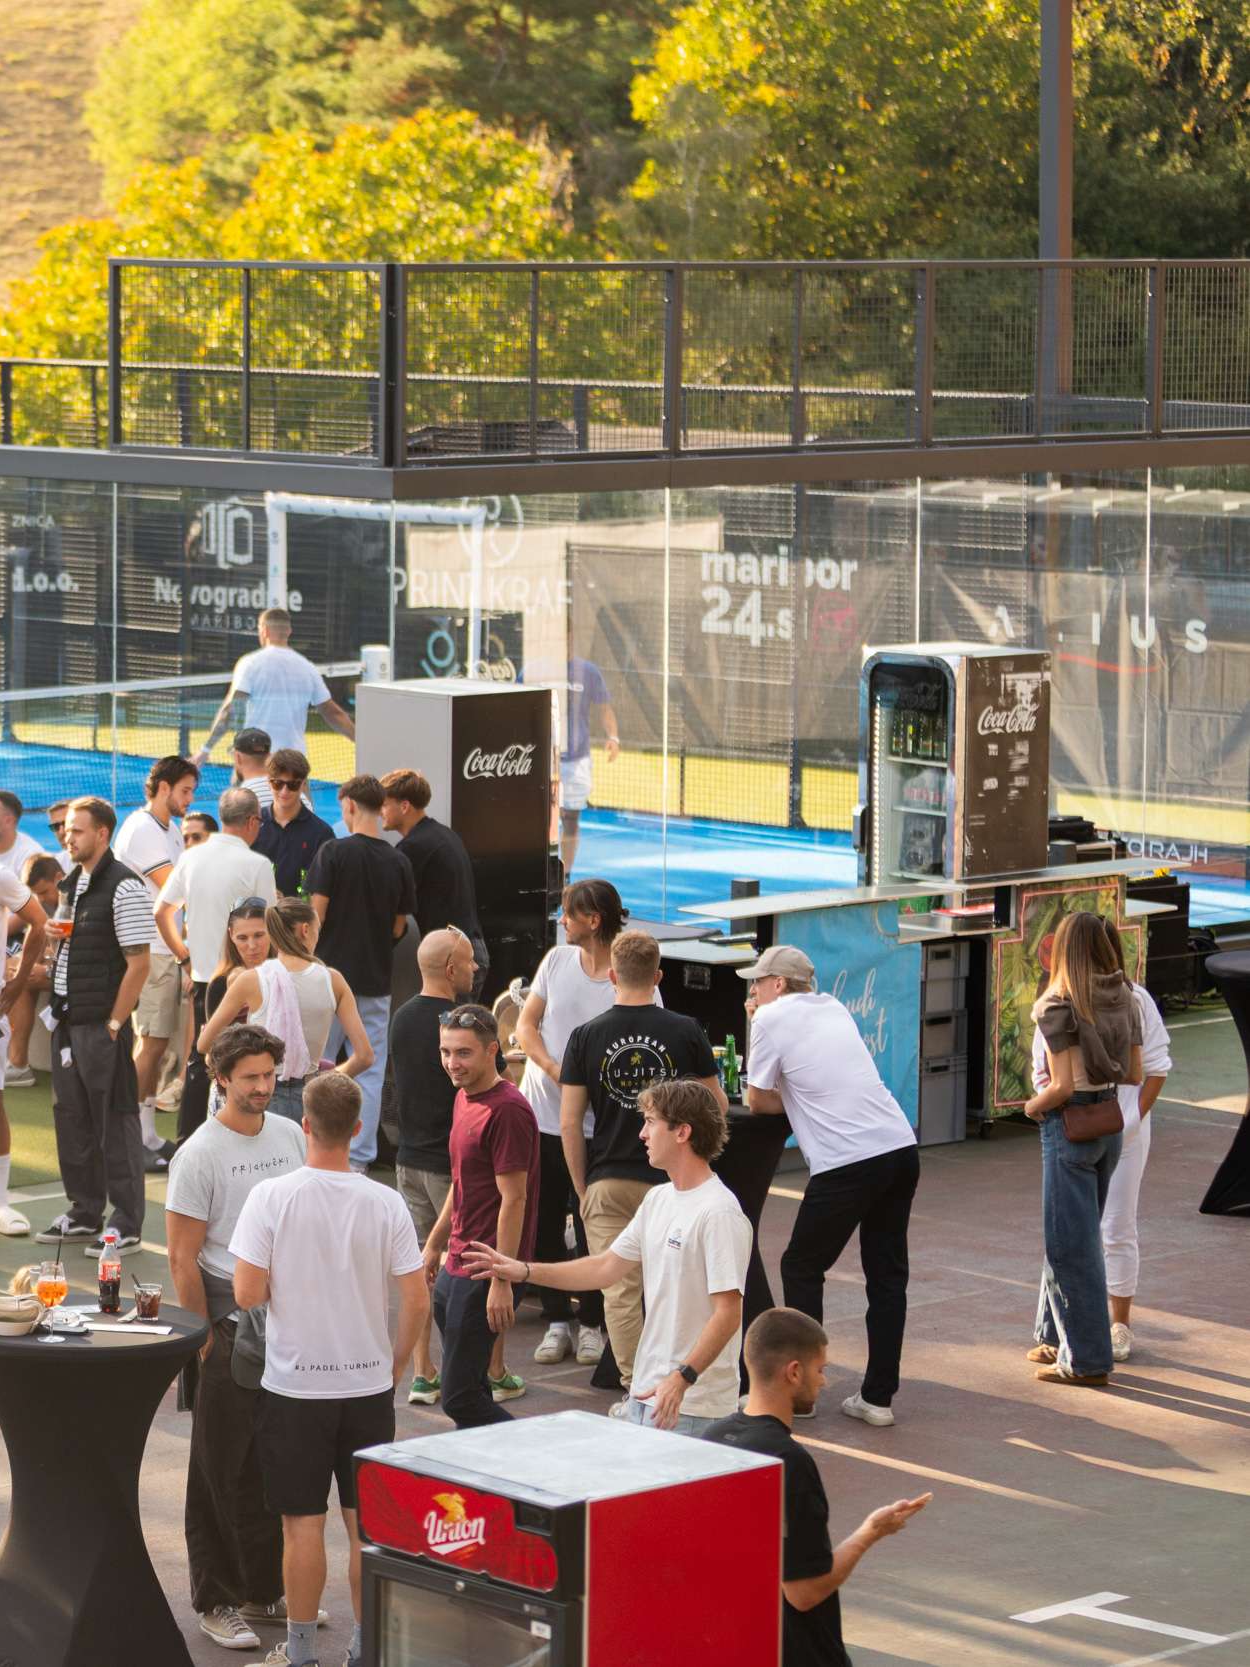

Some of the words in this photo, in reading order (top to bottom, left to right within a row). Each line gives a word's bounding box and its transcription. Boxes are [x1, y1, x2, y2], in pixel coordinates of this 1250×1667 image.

[978, 703, 1039, 736] Coca-Cola
[463, 744, 536, 780] Coca-Cola
[1150, 840, 1209, 865] RAJH
[605, 1035, 667, 1056] EUROPEAN
[310, 1364, 341, 1372] PADEL
